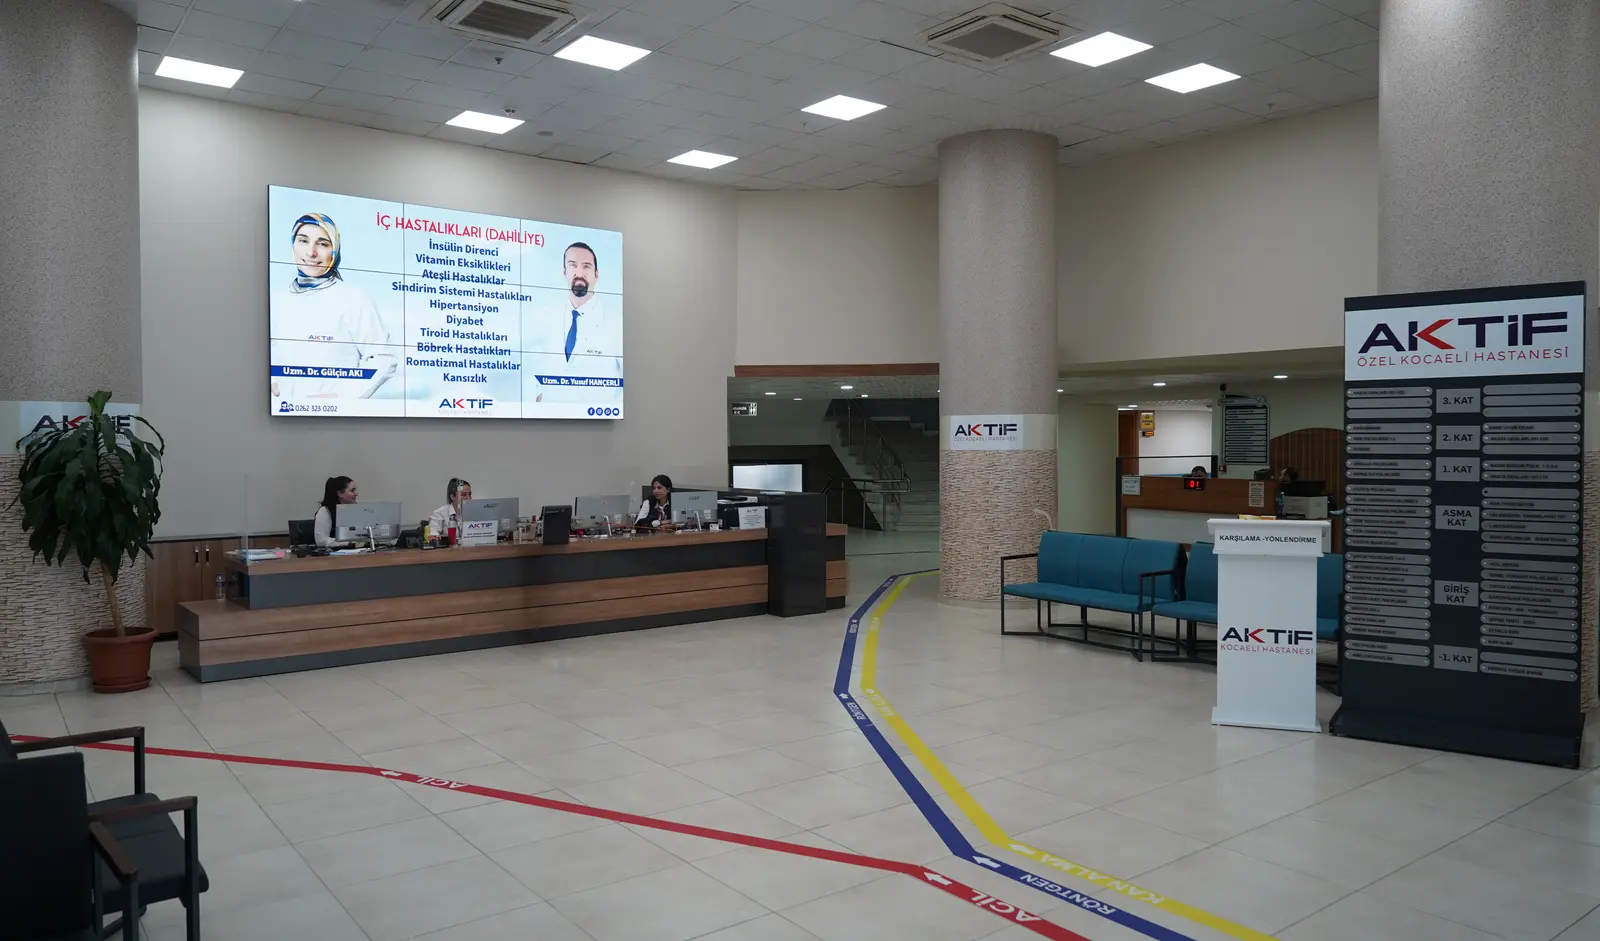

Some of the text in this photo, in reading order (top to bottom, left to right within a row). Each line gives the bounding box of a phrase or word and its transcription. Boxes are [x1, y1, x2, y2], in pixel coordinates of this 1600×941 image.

[376, 212, 545, 248] İÇ HASTALIKLARI (DAHİLİYE)
[429, 238, 499, 256] İnsülin Direnci
[416, 253, 511, 272] Vitamin Eksiklikleri
[422, 268, 506, 286] Ateşli Hastalıklar
[392, 282, 532, 302] Sindirim Sistemi Hastalıkları
[430, 299, 499, 315] Hipertansiyon
[446, 315, 484, 326] Diyabet
[420, 328, 508, 342] Tiroid Hastalıkları
[417, 342, 511, 356] Böbrek Hastalıkları
[406, 356, 521, 371] Romatizmal Hastalıklar
[1358, 346, 1568, 367] ÖZEL KOCAELİ HASTANESİ
[283, 367, 306, 375] Uzm.
[308, 368, 320, 376] Dr.
[321, 368, 348, 378] Gülçin
[443, 372, 487, 383] Kansızlık
[1454, 396, 1474, 404] KAT
[1453, 466, 1473, 474] KAT
[1442, 509, 1472, 518] ASMA
[1444, 584, 1470, 595] GİRİŞ
[1220, 644, 1314, 655] KOCAELİ HASTANESİ
[1439, 654, 1473, 664] -1. KAT
[1040, 854, 1167, 904] KAN ALMA
[1020, 874, 1117, 915] RÖNTGEN
